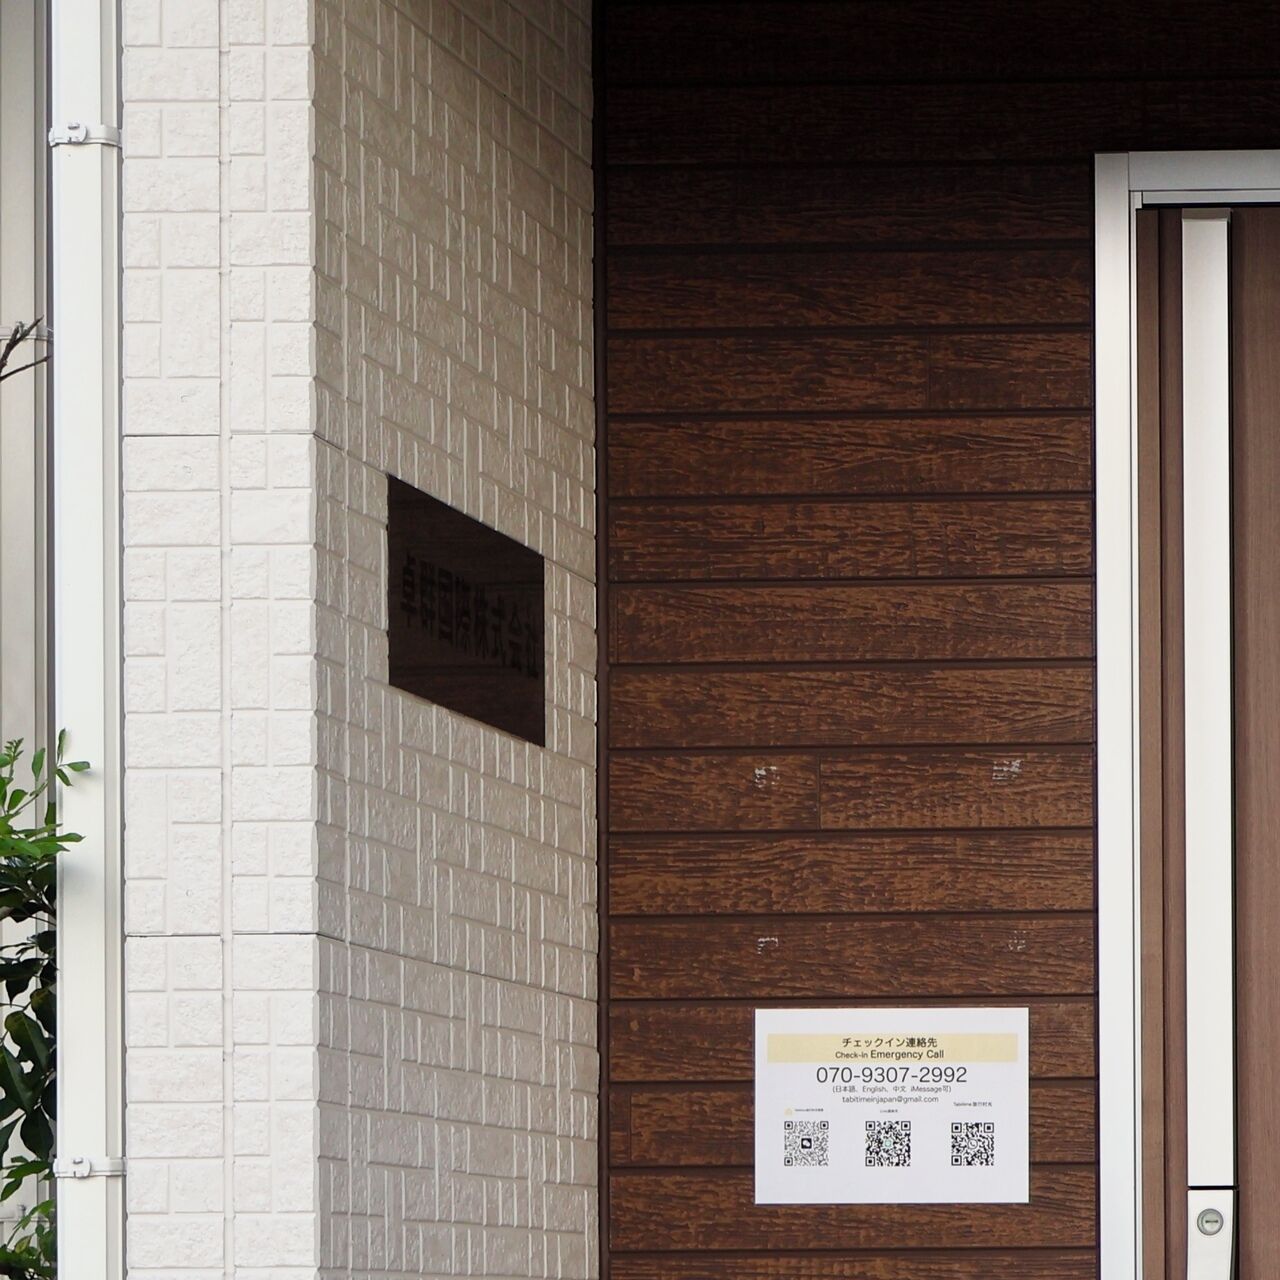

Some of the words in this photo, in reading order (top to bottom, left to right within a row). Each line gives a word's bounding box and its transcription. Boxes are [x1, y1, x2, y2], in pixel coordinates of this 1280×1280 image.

[842, 1037, 938, 1048] チェックイン連絡先
[835, 1050, 868, 1059] Check-in
[870, 1050, 923, 1061] Emergency
[926, 1049, 945, 1059] Call
[816, 1066, 968, 1083] 070-9307-2992
